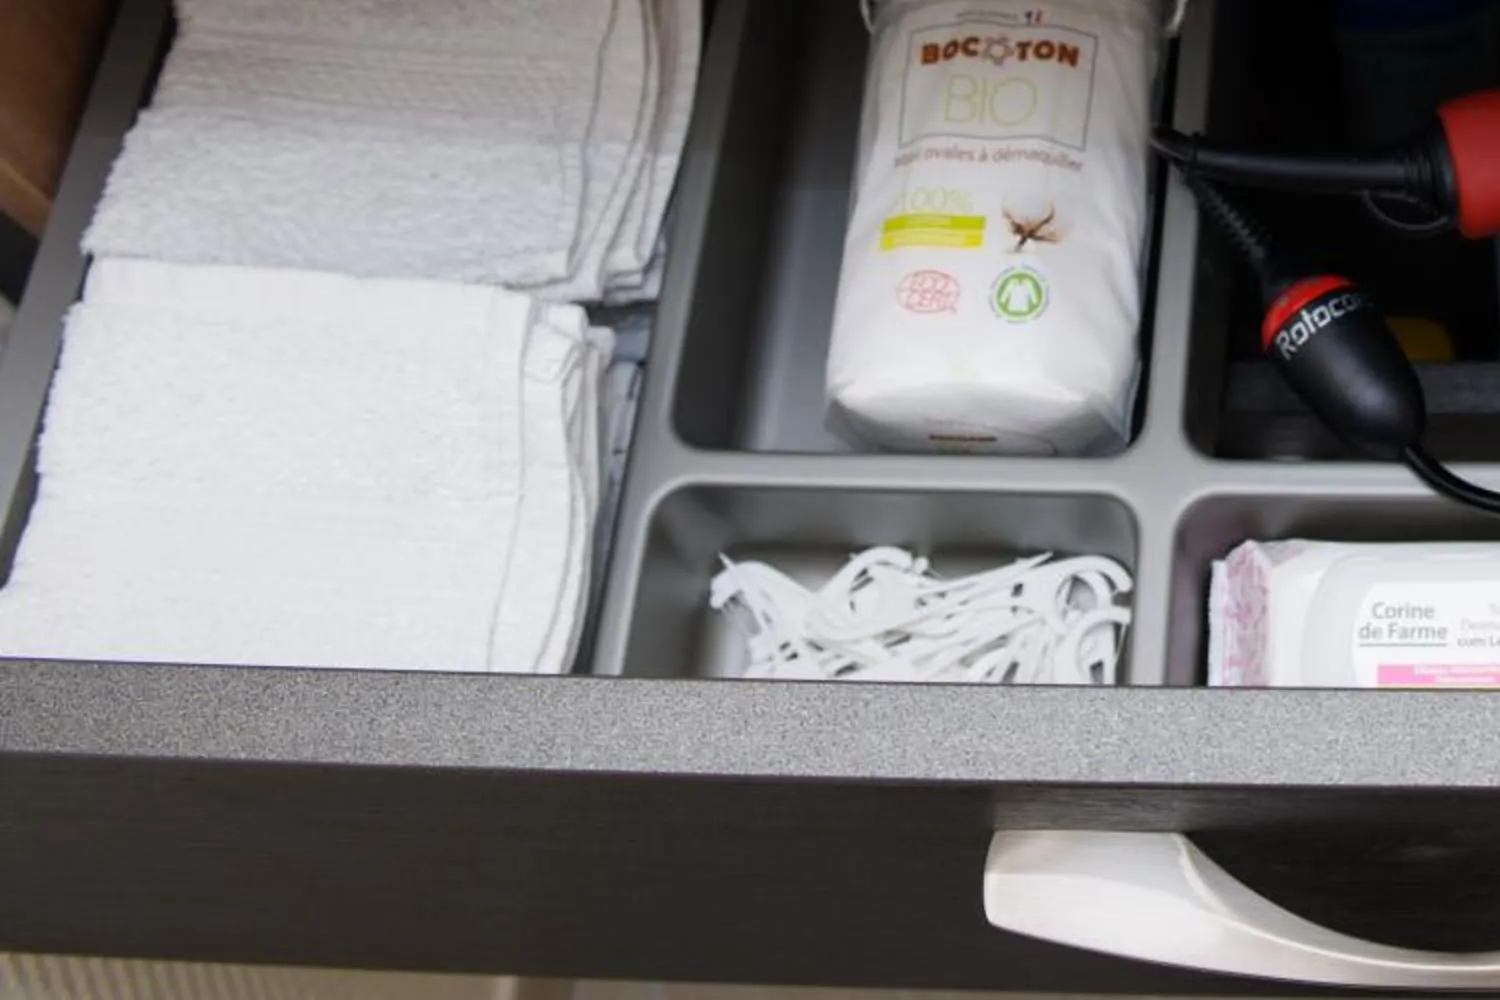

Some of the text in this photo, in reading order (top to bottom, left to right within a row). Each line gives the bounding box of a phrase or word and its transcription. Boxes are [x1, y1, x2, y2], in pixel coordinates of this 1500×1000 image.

[943, 74, 1038, 127] BIO
[1371, 602, 1435, 619] Corine
[1358, 622, 1448, 640] de Farme
[1457, 637, 1486, 647] com
